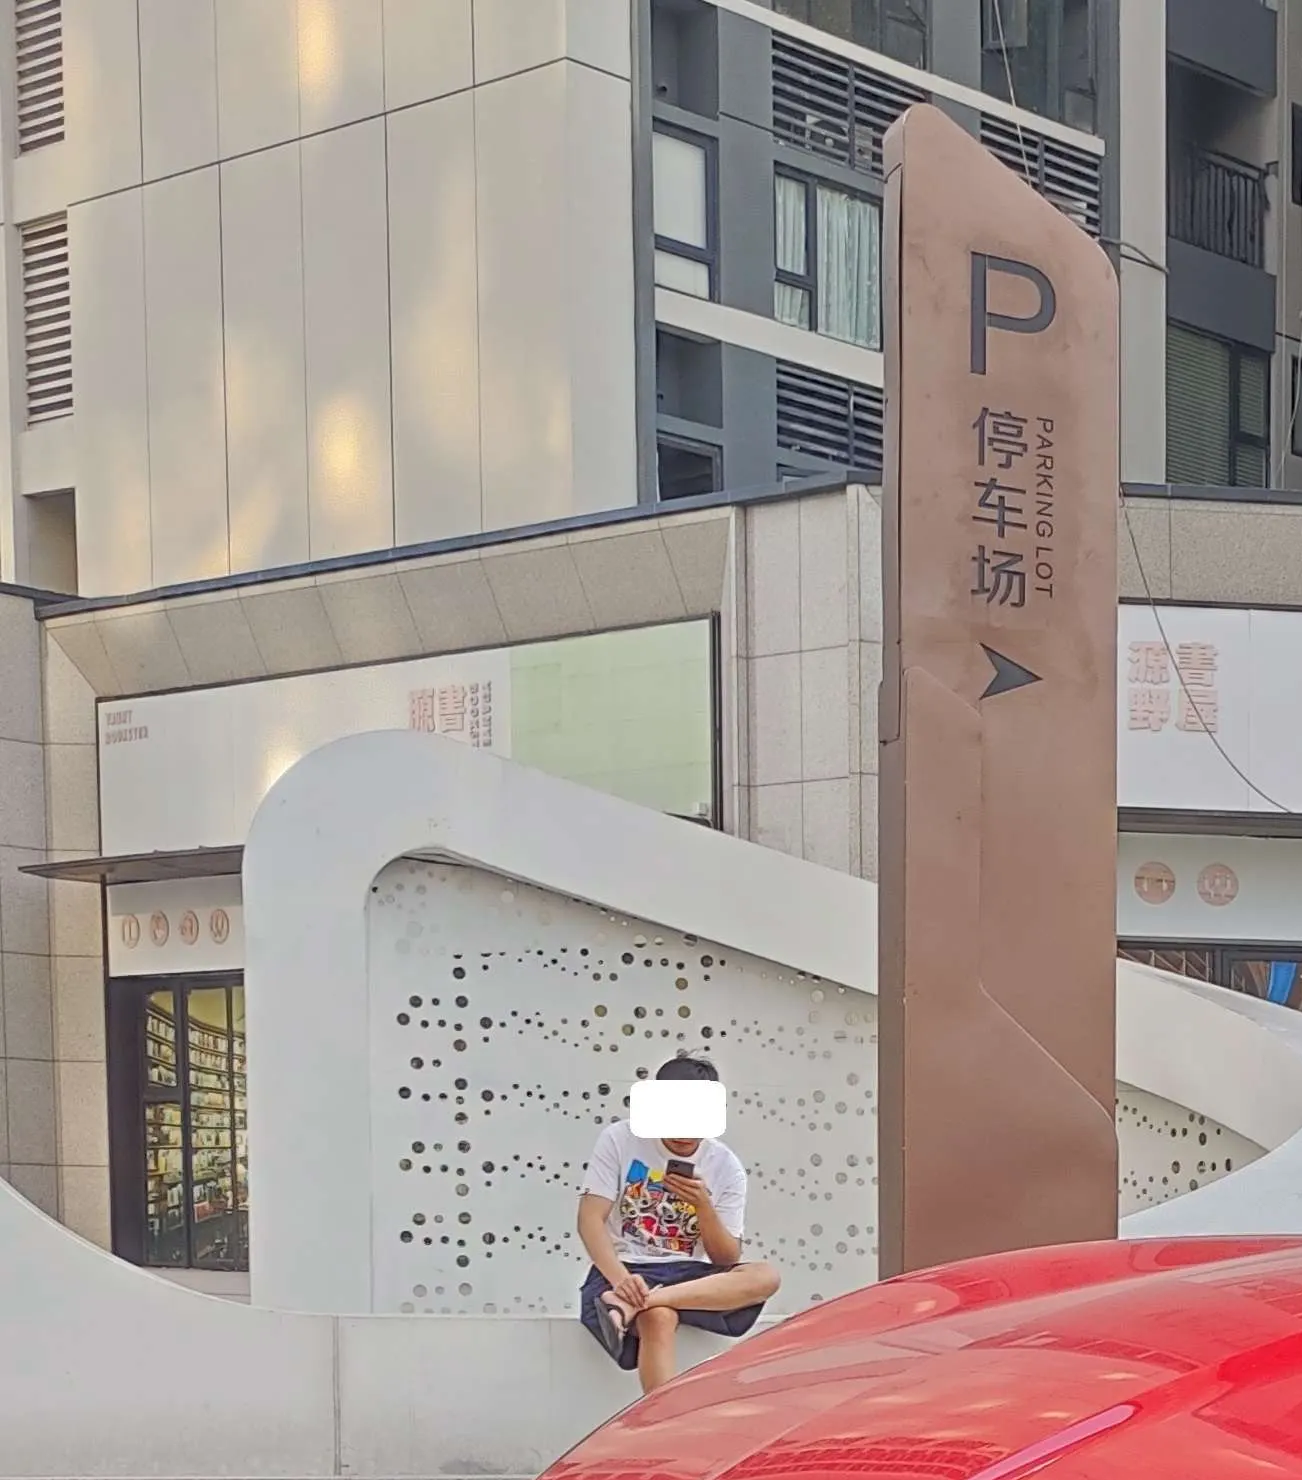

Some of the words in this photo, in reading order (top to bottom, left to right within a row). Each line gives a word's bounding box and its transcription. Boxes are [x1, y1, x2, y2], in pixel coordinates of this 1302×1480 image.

[970, 251, 1057, 376] P
[971, 406, 1029, 609] 停车场
[1034, 416, 1055, 539] PARKING
[1035, 546, 1054, 599] LOT
